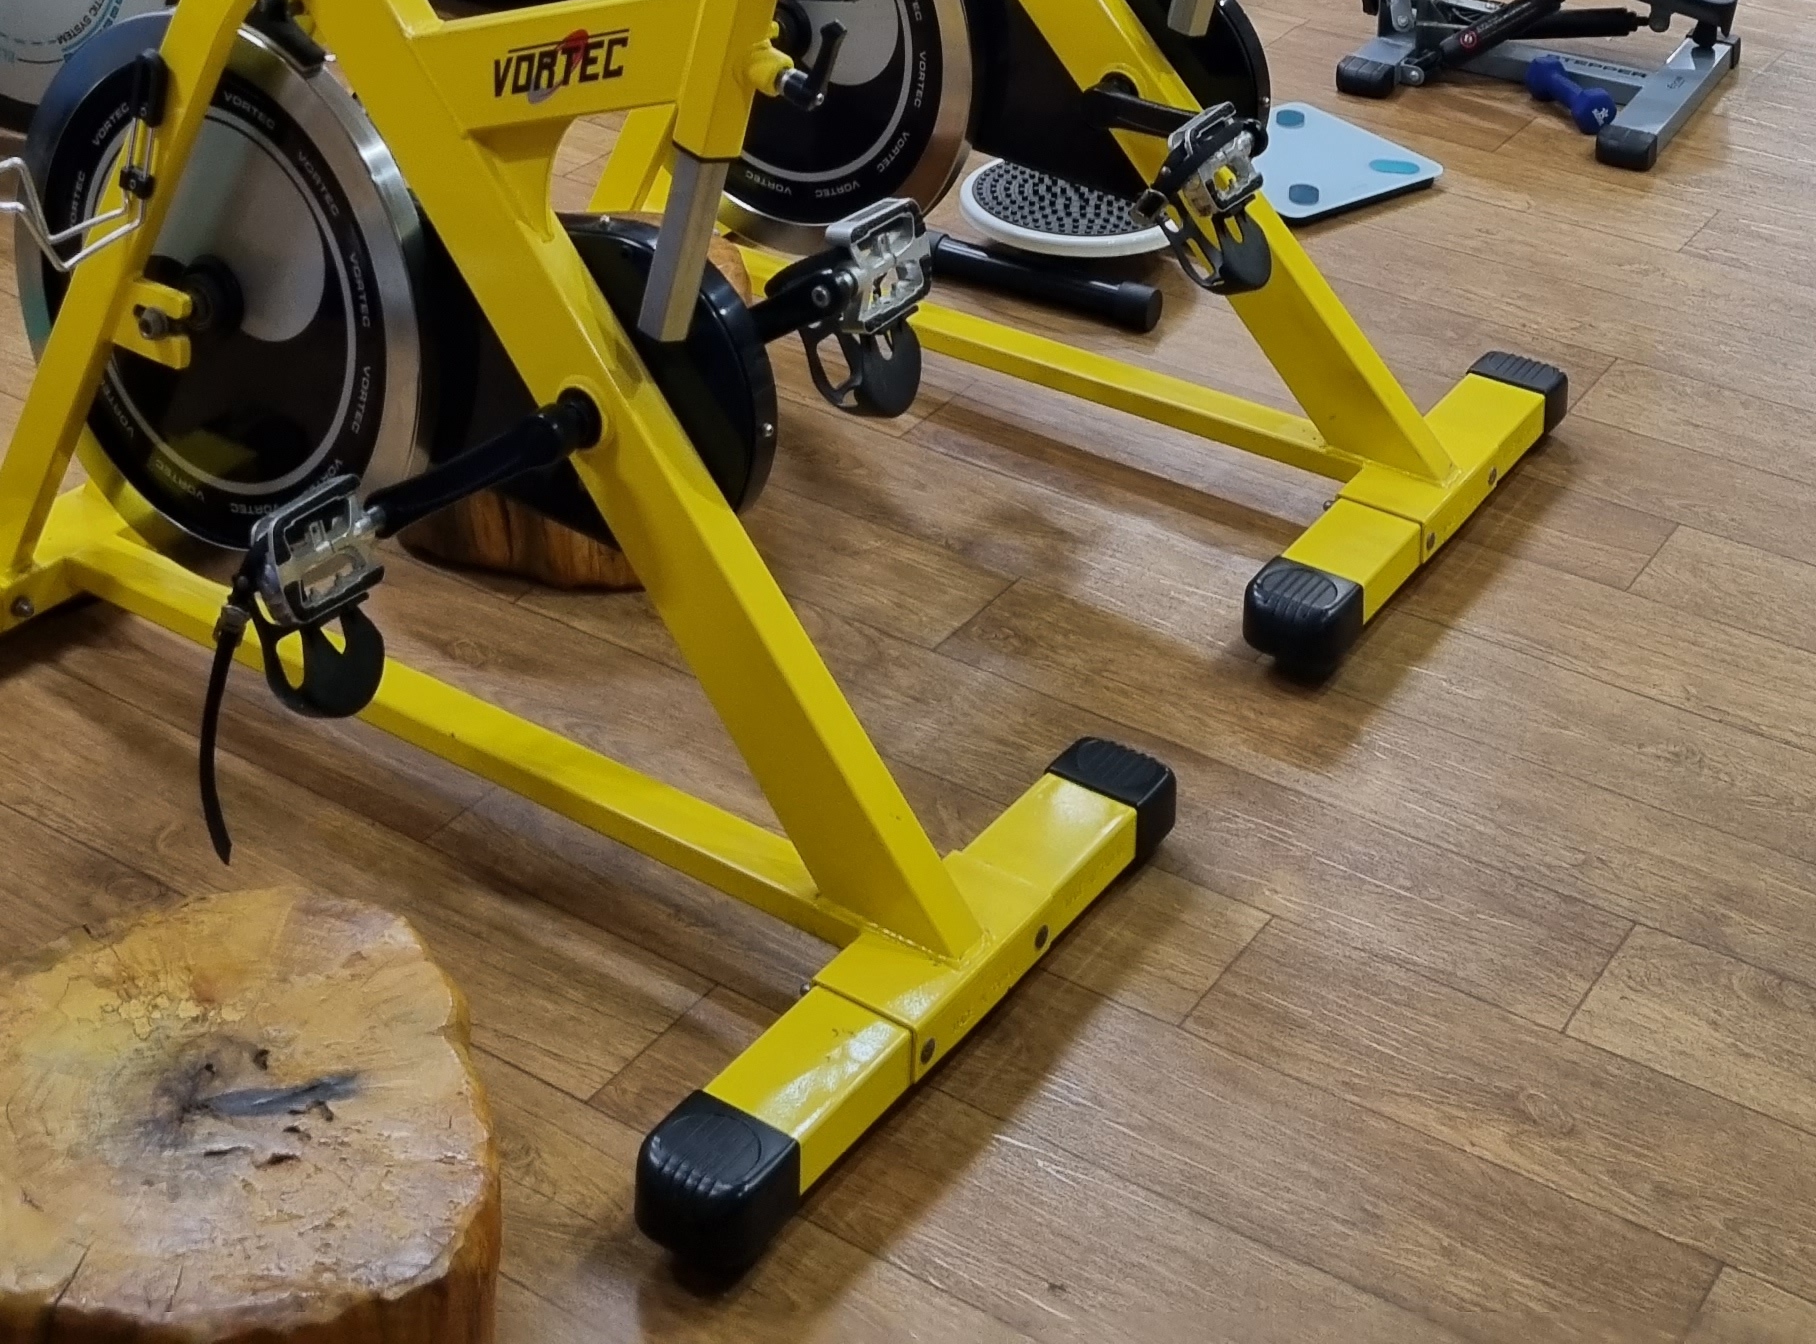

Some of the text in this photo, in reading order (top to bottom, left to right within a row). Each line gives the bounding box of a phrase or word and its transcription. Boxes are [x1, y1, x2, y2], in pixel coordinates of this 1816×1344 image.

[57, 15, 92, 45] SYSTEM
[494, 35, 629, 98] VORTEC
[913, 51, 926, 109] VORTEC
[92, 101, 130, 147] VORTEC
[222, 90, 276, 131] VORTEC
[876, 131, 910, 174] VORTEC
[70, 170, 86, 227] ORTEC
[298, 150, 340, 218] VORTEC
[745, 169, 792, 196] VORTEC
[814, 179, 861, 199] VORTEC
[349, 252, 372, 329] VORTEC
[351, 365, 372, 435] VORTEC
[155, 459, 206, 504] VORTEC
